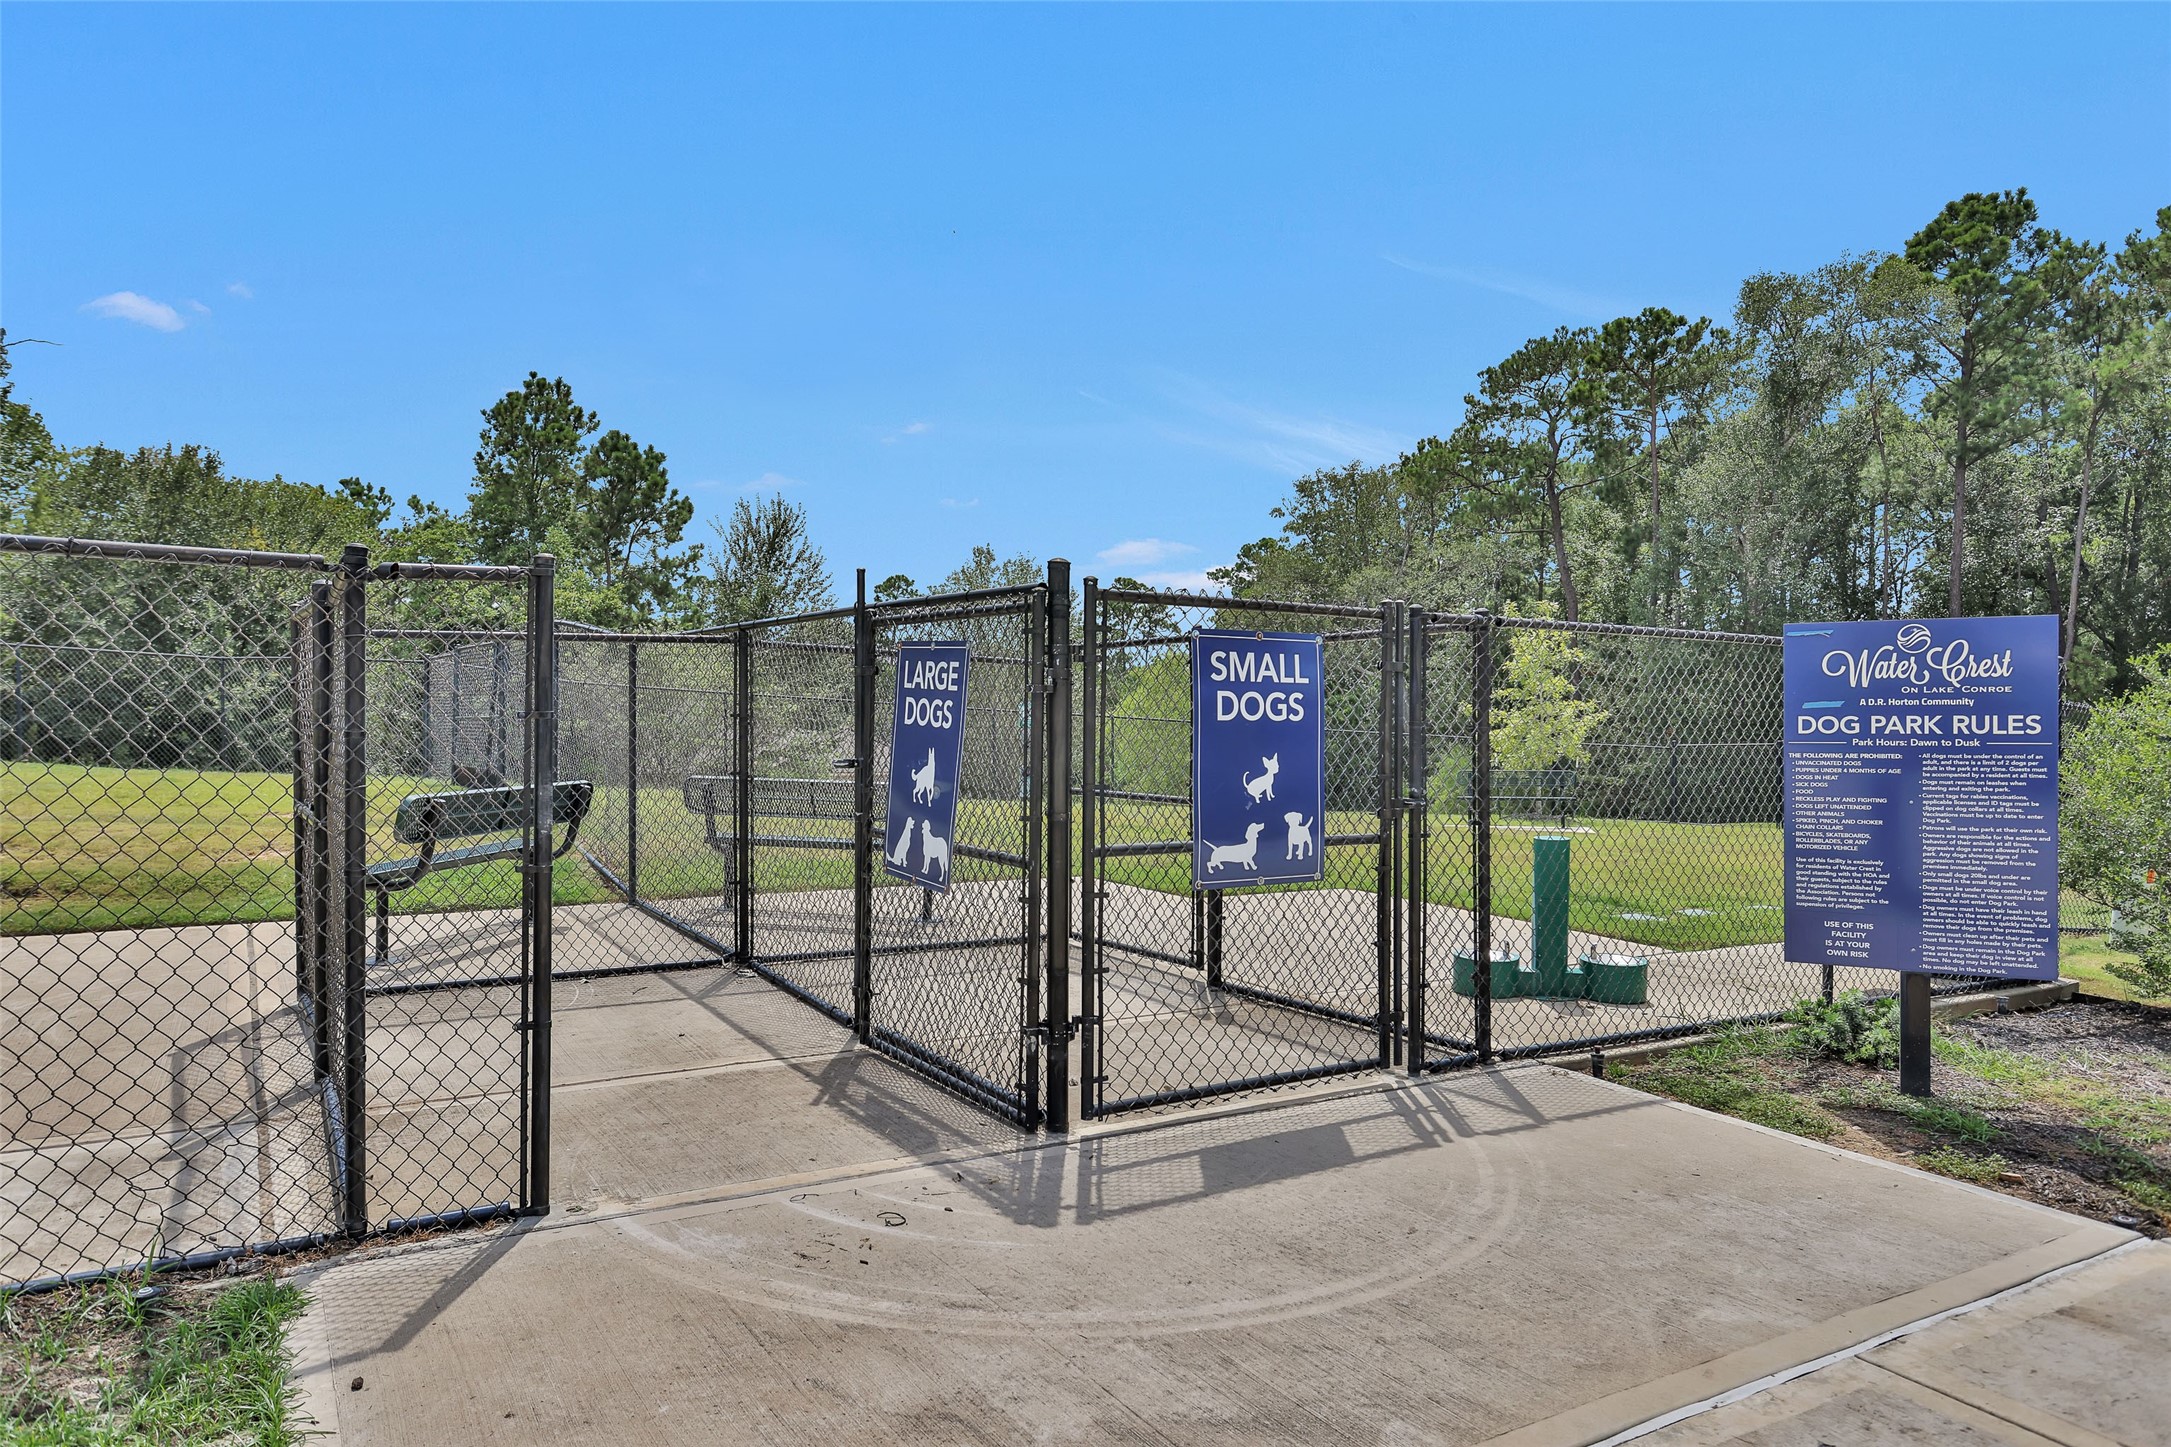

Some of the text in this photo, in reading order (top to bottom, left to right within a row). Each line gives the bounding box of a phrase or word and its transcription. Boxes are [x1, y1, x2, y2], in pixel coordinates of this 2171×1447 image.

[904, 660, 959, 691] LARGE
[1211, 651, 1309, 684] SMALL
[1821, 639, 2014, 688] Water Crest
[905, 697, 952, 729] DOGS
[1217, 690, 1304, 721] DOGS
[1921, 698, 1974, 707] Community
[1798, 715, 2041, 734] DOG PARK RULES
